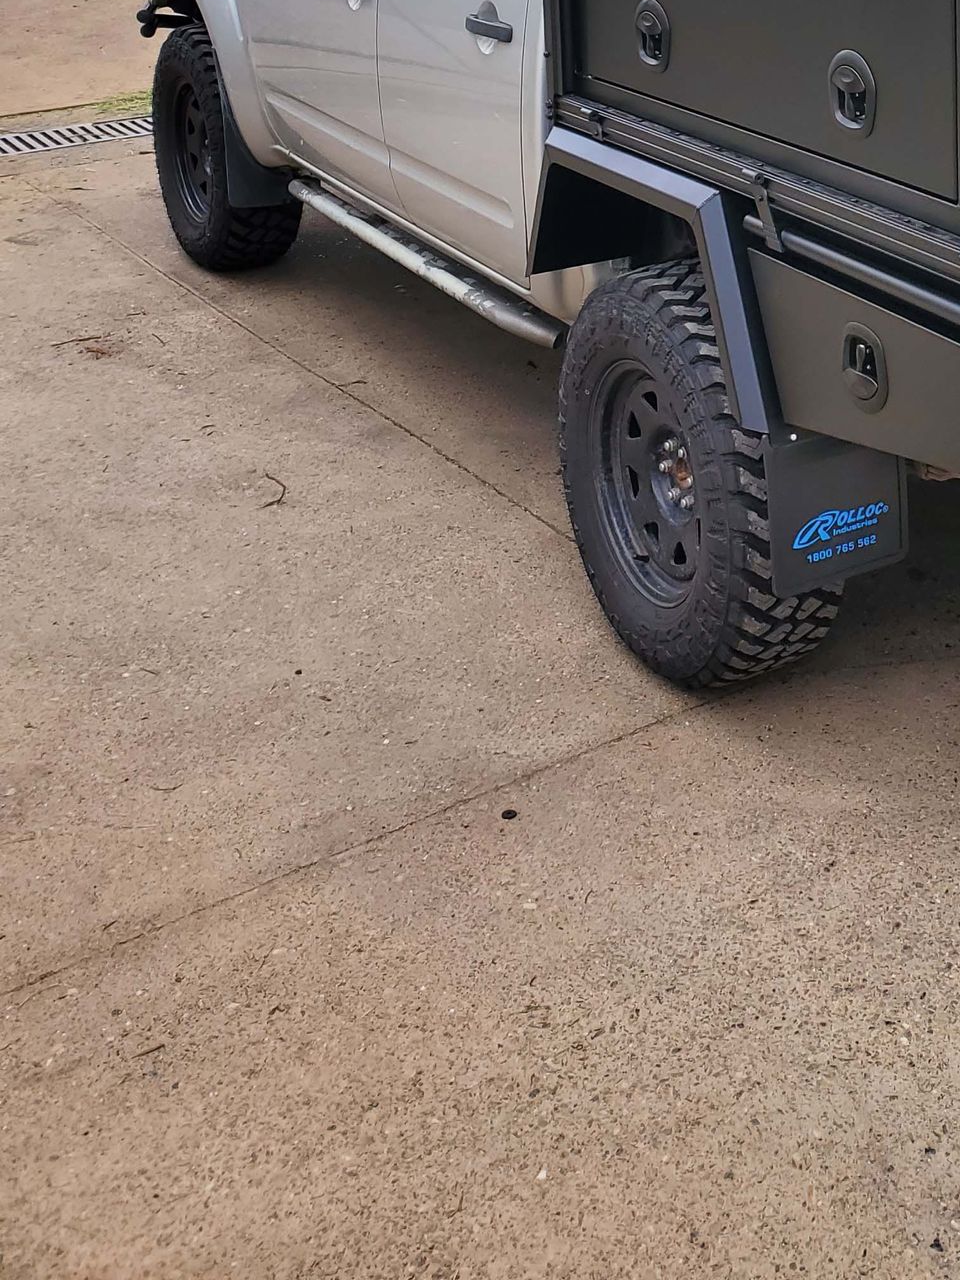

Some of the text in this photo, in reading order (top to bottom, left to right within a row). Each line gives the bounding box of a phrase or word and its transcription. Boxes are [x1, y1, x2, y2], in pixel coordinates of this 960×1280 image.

[832, 518, 878, 536] Industries
[806, 534, 877, 563] 1800 765 562
